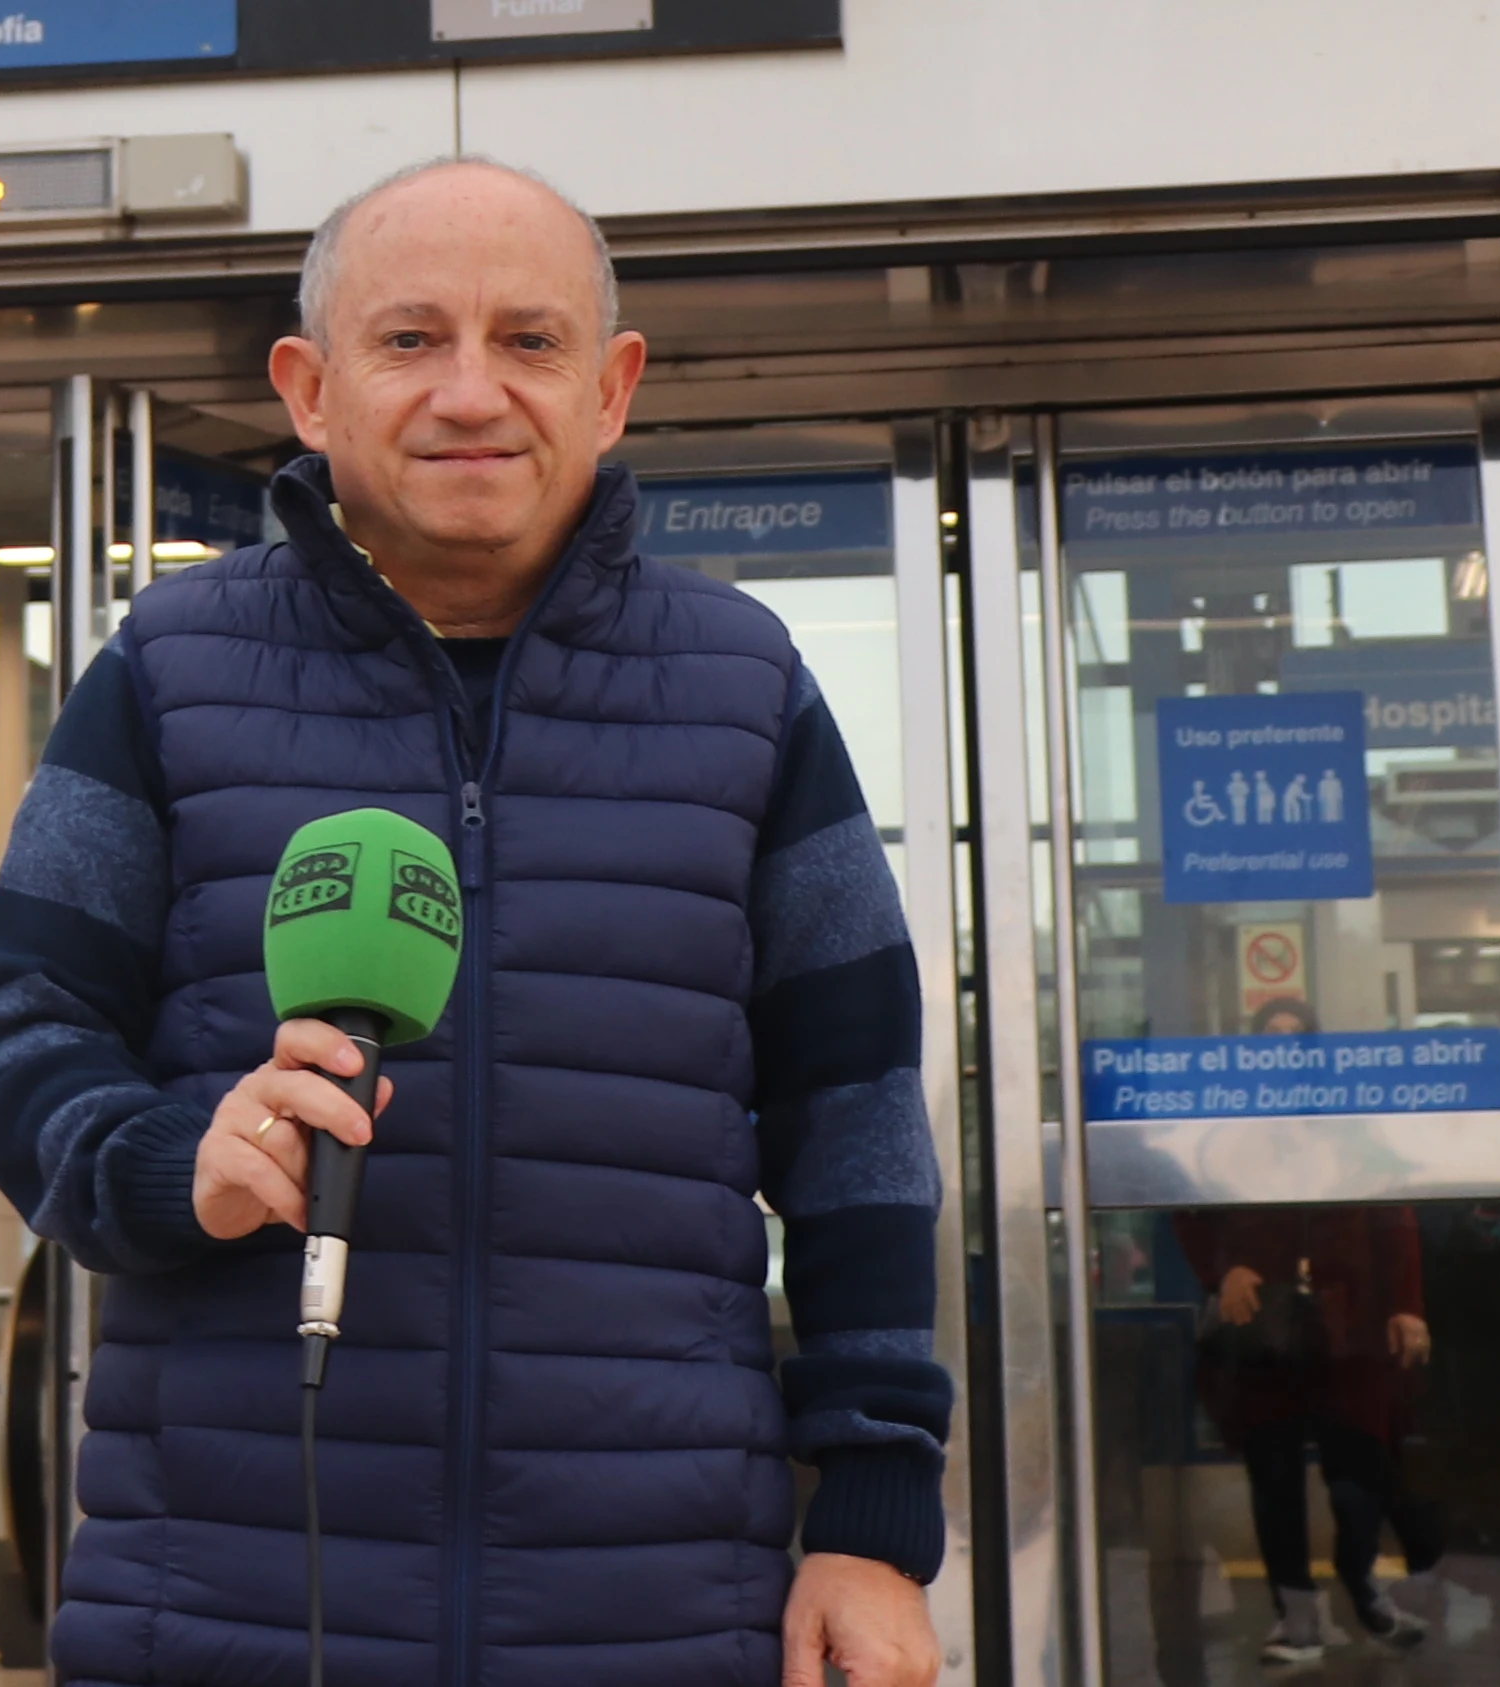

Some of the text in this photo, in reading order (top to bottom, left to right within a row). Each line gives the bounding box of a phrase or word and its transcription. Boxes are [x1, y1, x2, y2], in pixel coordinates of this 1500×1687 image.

[1066, 458, 1435, 497] Pulsar el botón para abrir
[665, 499, 823, 533] Entrance
[1085, 496, 1417, 531] Press the button to open
[1363, 694, 1498, 735] Hospita
[1175, 723, 1346, 749] Uso preferente
[282, 858, 343, 884] ONDA
[1183, 849, 1349, 872] Preferential use
[280, 884, 340, 910] CERO
[1092, 1038, 1487, 1074] Pulsar el botón para abrir
[1114, 1081, 1467, 1112] Press the button to open
